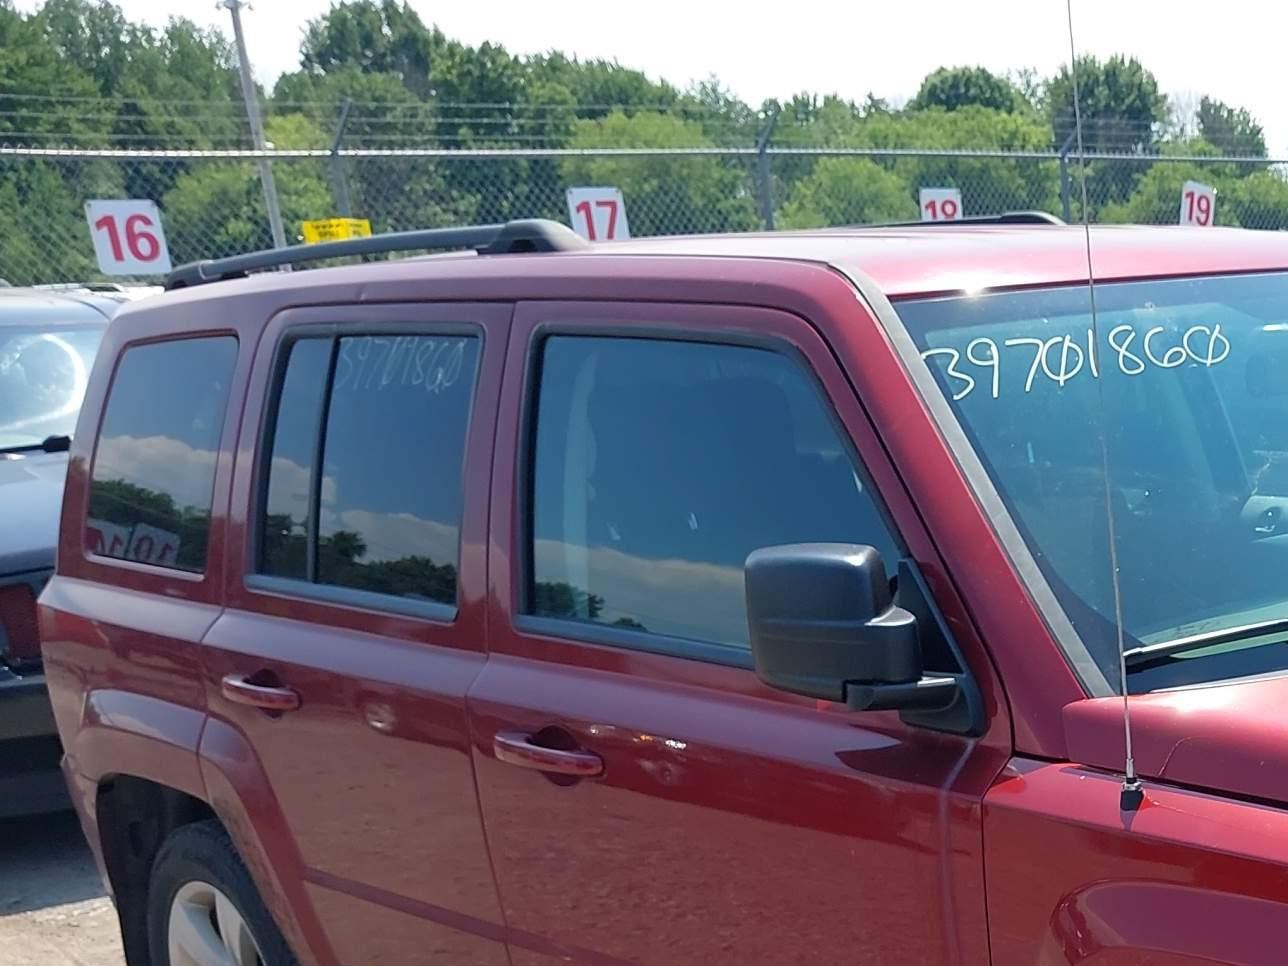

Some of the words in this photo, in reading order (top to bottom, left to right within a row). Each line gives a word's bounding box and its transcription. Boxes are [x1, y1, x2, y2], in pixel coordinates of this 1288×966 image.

[575, 201, 617, 240] 17
[1185, 191, 1210, 226] 19
[95, 214, 160, 263] 16
[921, 324, 1231, 401] 39701860
